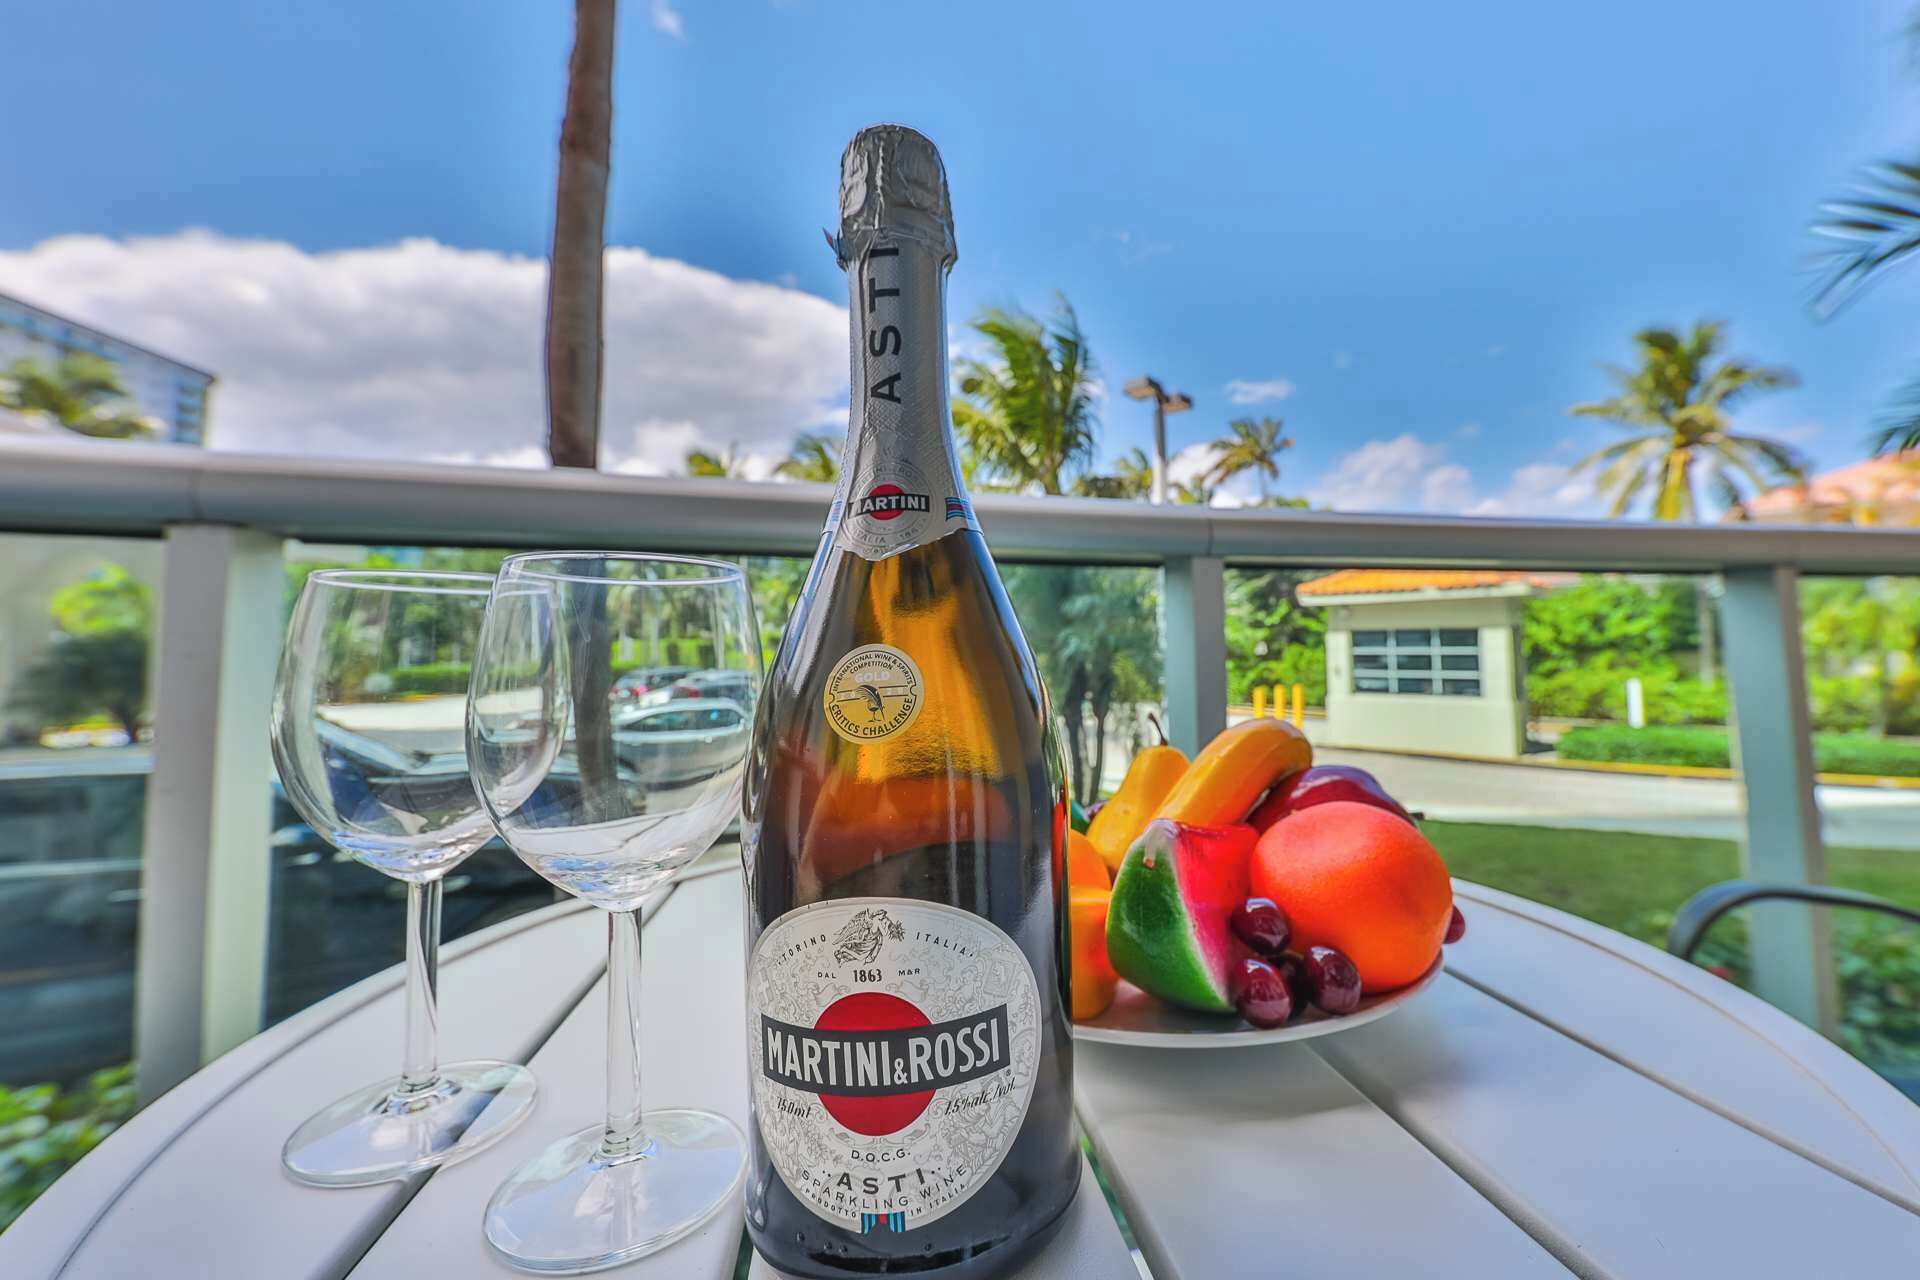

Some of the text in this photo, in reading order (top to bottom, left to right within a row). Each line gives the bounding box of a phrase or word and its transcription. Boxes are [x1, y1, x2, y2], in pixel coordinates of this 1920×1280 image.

[868, 248, 902, 403] ASTI
[833, 653, 873, 692] INTERNATIONAL
[874, 653, 893, 662] WINE
[896, 662, 913, 685] SPIRITS
[849, 660, 894, 674] COMPETITION
[855, 671, 890, 683] GOLD
[831, 698, 913, 736] CRITICS CHALLENGE
[782, 932, 967, 961] TORINO ITALIA
[817, 971, 837, 979] DAL
[853, 968, 883, 983] 1863
[801, 1164, 967, 1209] SPARKLING WINE
[837, 1168, 925, 1195] ASTI
[805, 1187, 857, 1218] PRODOTTO
